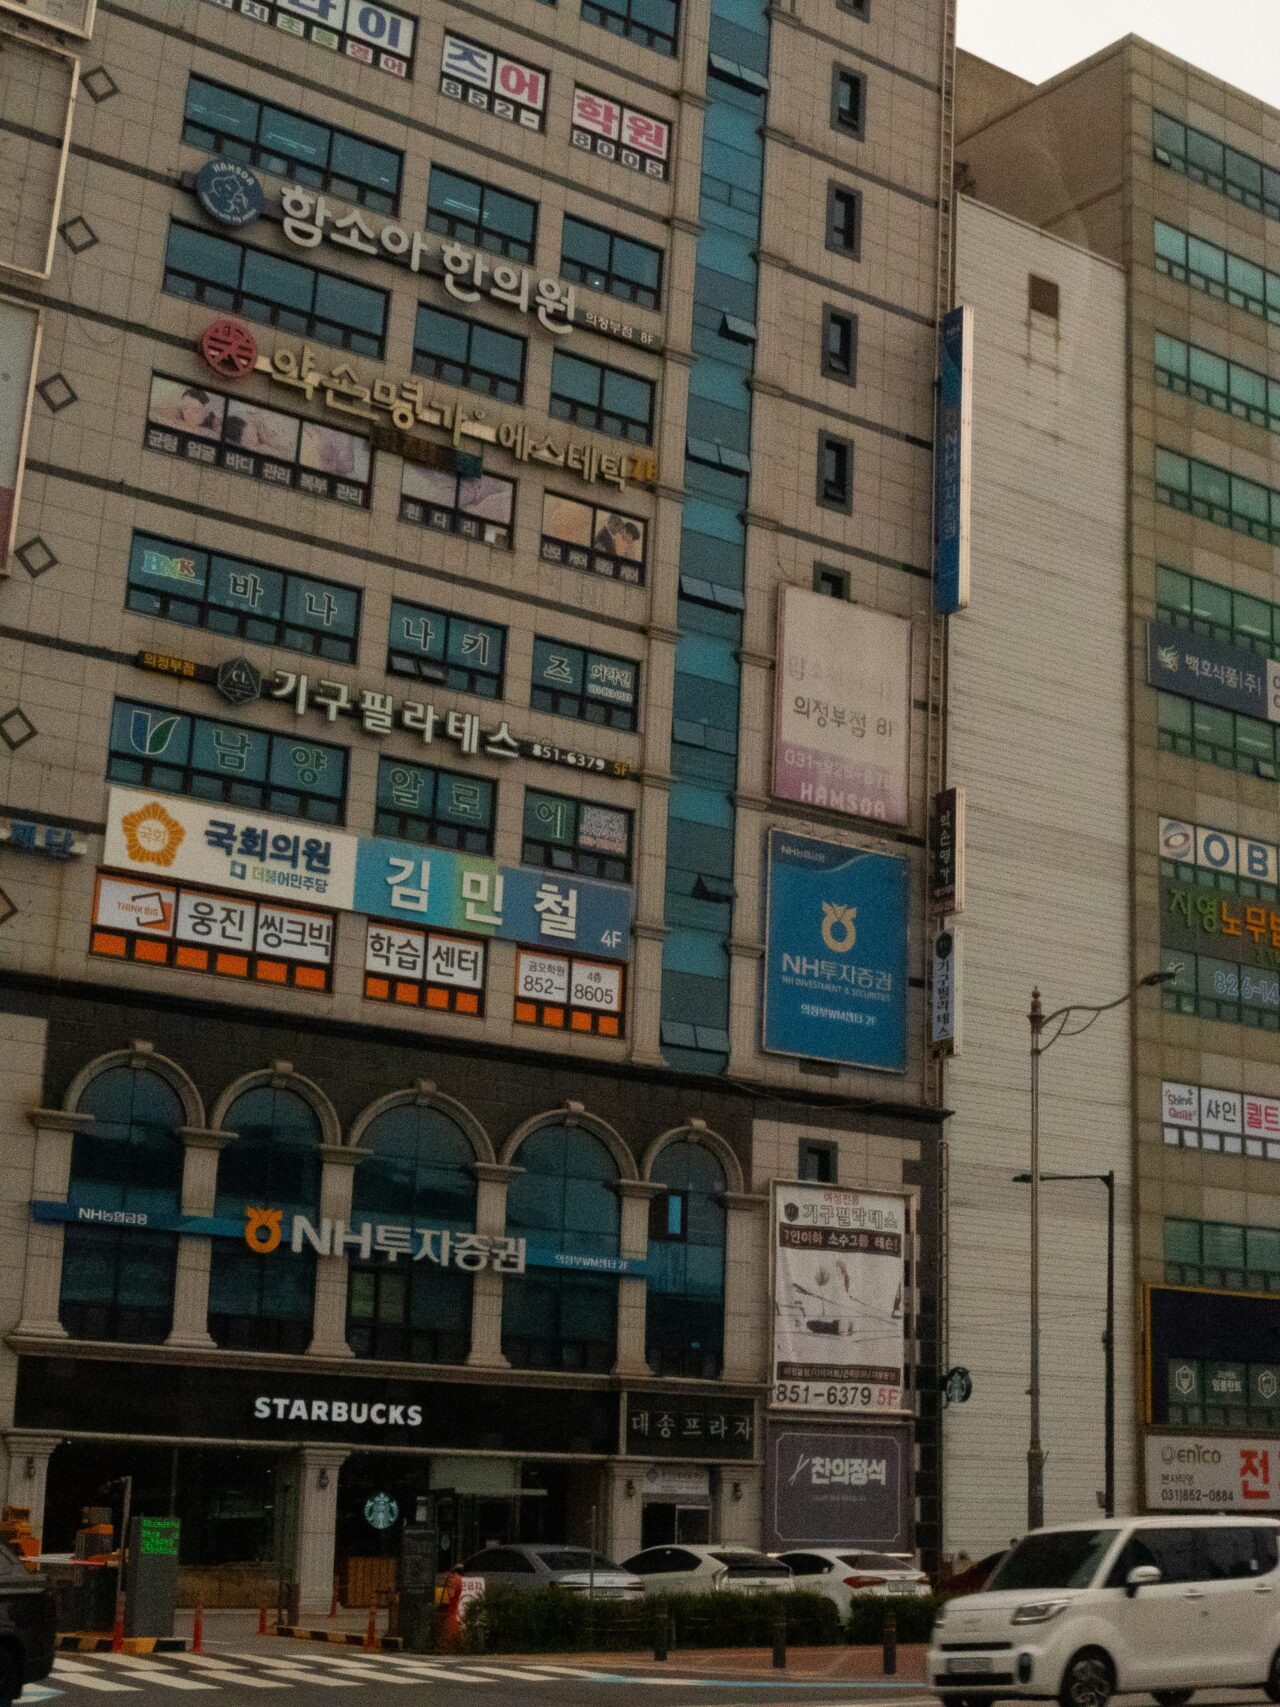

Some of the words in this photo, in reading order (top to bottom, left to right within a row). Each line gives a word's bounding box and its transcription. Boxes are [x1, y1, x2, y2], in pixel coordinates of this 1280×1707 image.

[281, 184, 427, 272] 함소아
[440, 241, 575, 335] 한의원
[497, 419, 628, 493] 에스테틱
[272, 669, 520, 758] 기구필라테스
[531, 743, 605, 771] 851-6379
[793, 695, 867, 739] 의정부점
[204, 818, 331, 875] 국회의원
[251, 865, 329, 893] 더불어민주당
[386, 857, 578, 940] 김민철
[600, 929, 622, 948] 4F
[188, 901, 245, 941] 웅진
[259, 913, 331, 956] 씽크빅
[782, 953, 892, 992] NH투자증권
[803, 1204, 898, 1230] 기구필라테스
[291, 1214, 527, 1275] NH투자증권
[254, 1396, 424, 1428] STARBUCKS
[776, 1384, 872, 1406] 851-6379
[631, 1409, 753, 1441] 대송프라자
